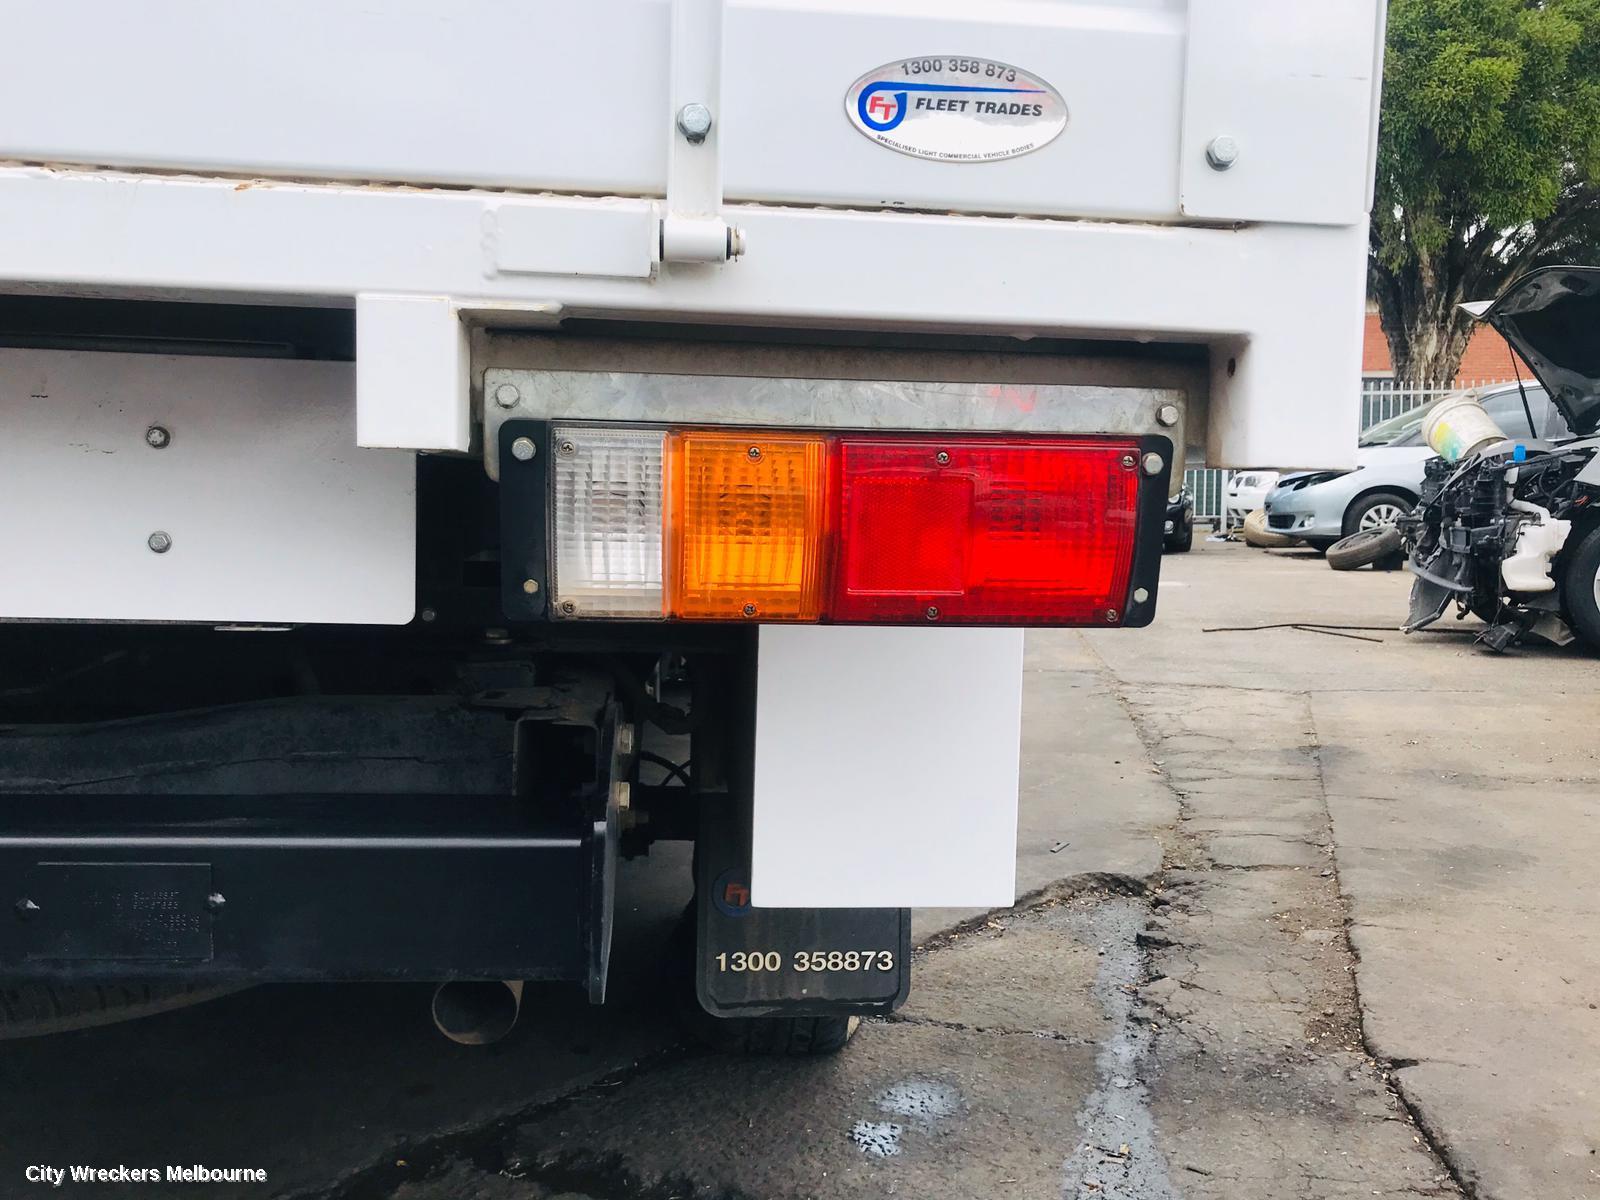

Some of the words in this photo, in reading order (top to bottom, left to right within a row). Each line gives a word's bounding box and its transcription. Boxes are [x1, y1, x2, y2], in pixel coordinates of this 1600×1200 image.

[901, 59, 943, 76] 1300
[949, 59, 980, 74] 358
[985, 63, 1017, 83] 873
[868, 96, 897, 120] FT
[915, 97, 970, 112] FLEET
[975, 101, 1044, 117] TRADES
[876, 134, 918, 153] SPECIALISED
[918, 149, 938, 157] LIGHT
[939, 152, 982, 160] COMMERCIAL
[983, 150, 1010, 158] VEHICLE
[1011, 142, 1035, 154] BODIES
[715, 952, 782, 972] 1300
[793, 951, 894, 971] 358873
